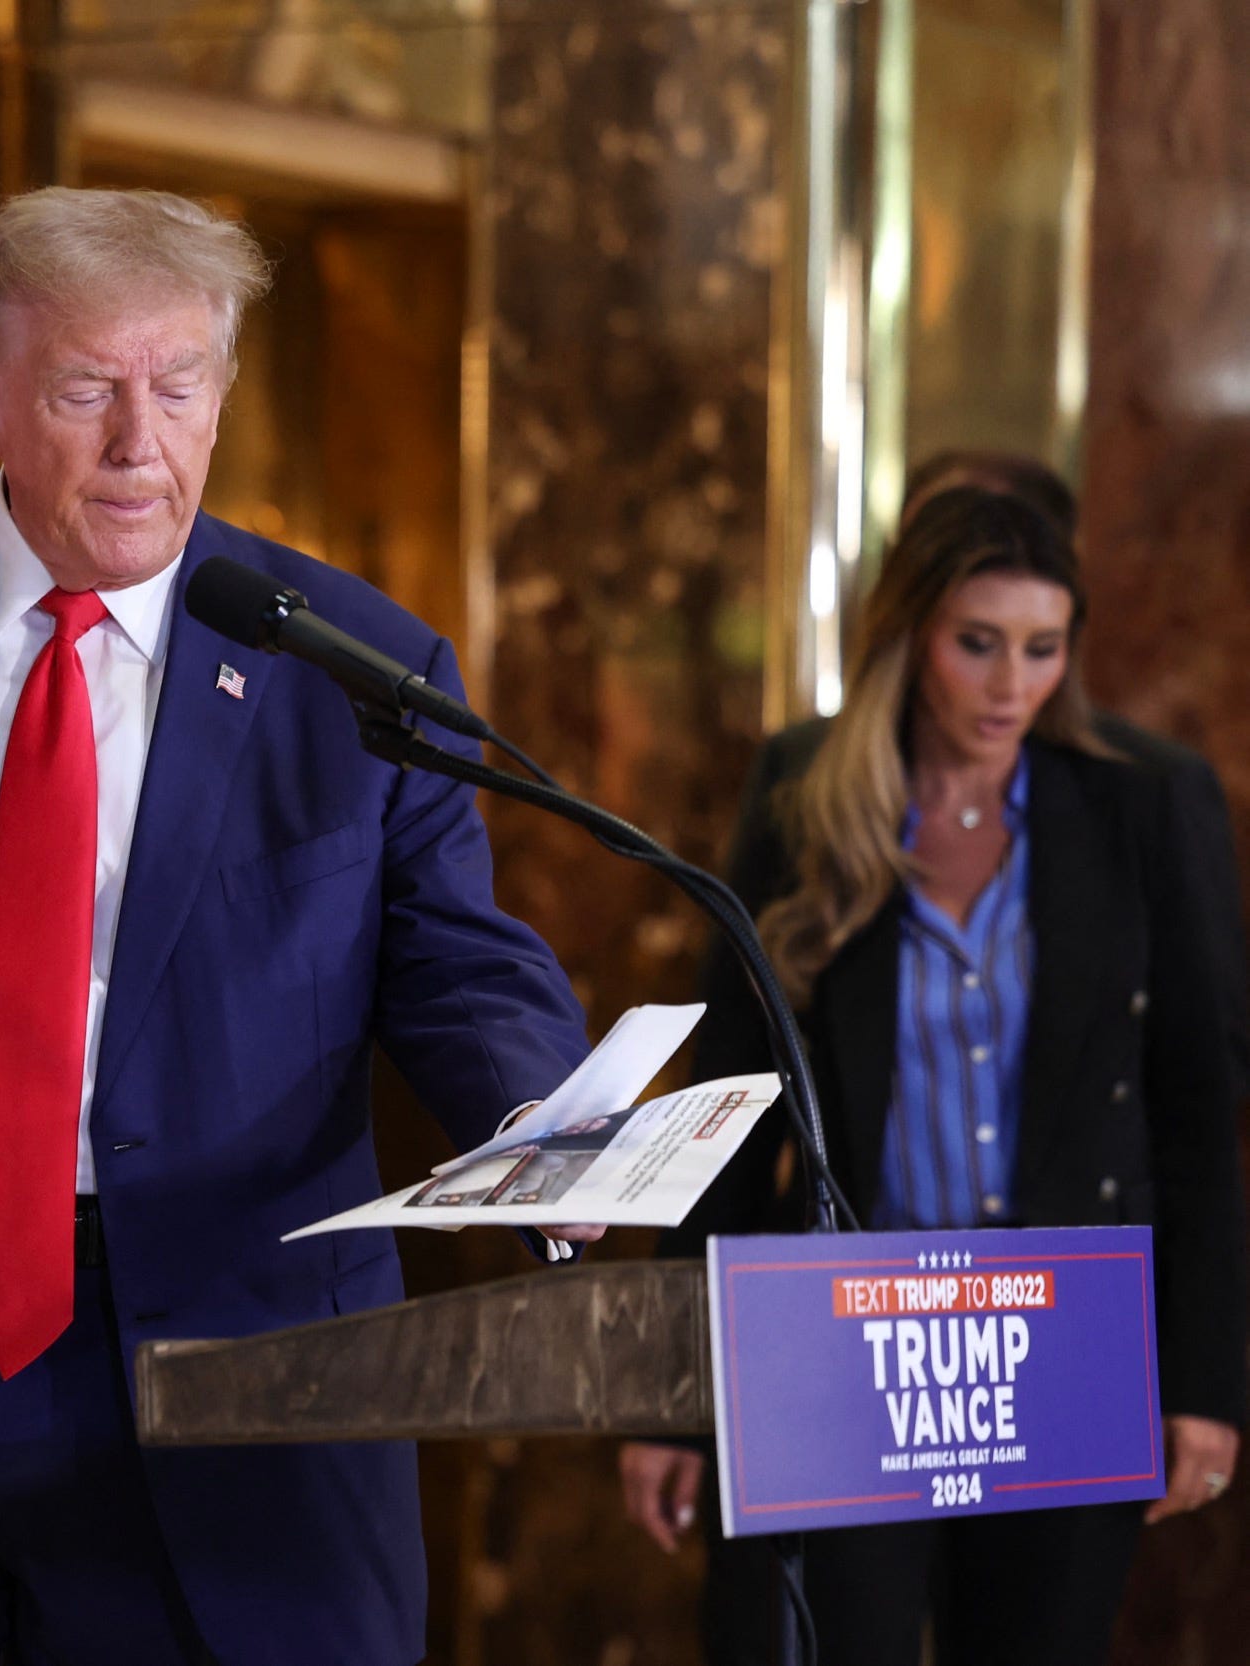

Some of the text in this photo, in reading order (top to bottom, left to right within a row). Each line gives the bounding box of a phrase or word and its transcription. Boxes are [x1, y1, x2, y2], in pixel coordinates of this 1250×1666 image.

[842, 1275, 1045, 1313] TEXT TRUMP TO 88022
[864, 1315, 1029, 1390] TRUMP
[886, 1386, 1016, 1447] VANCE
[882, 1446, 1026, 1471] MAKE AMERICA GREAT AGAIN!
[932, 1473, 982, 1506] 2024
